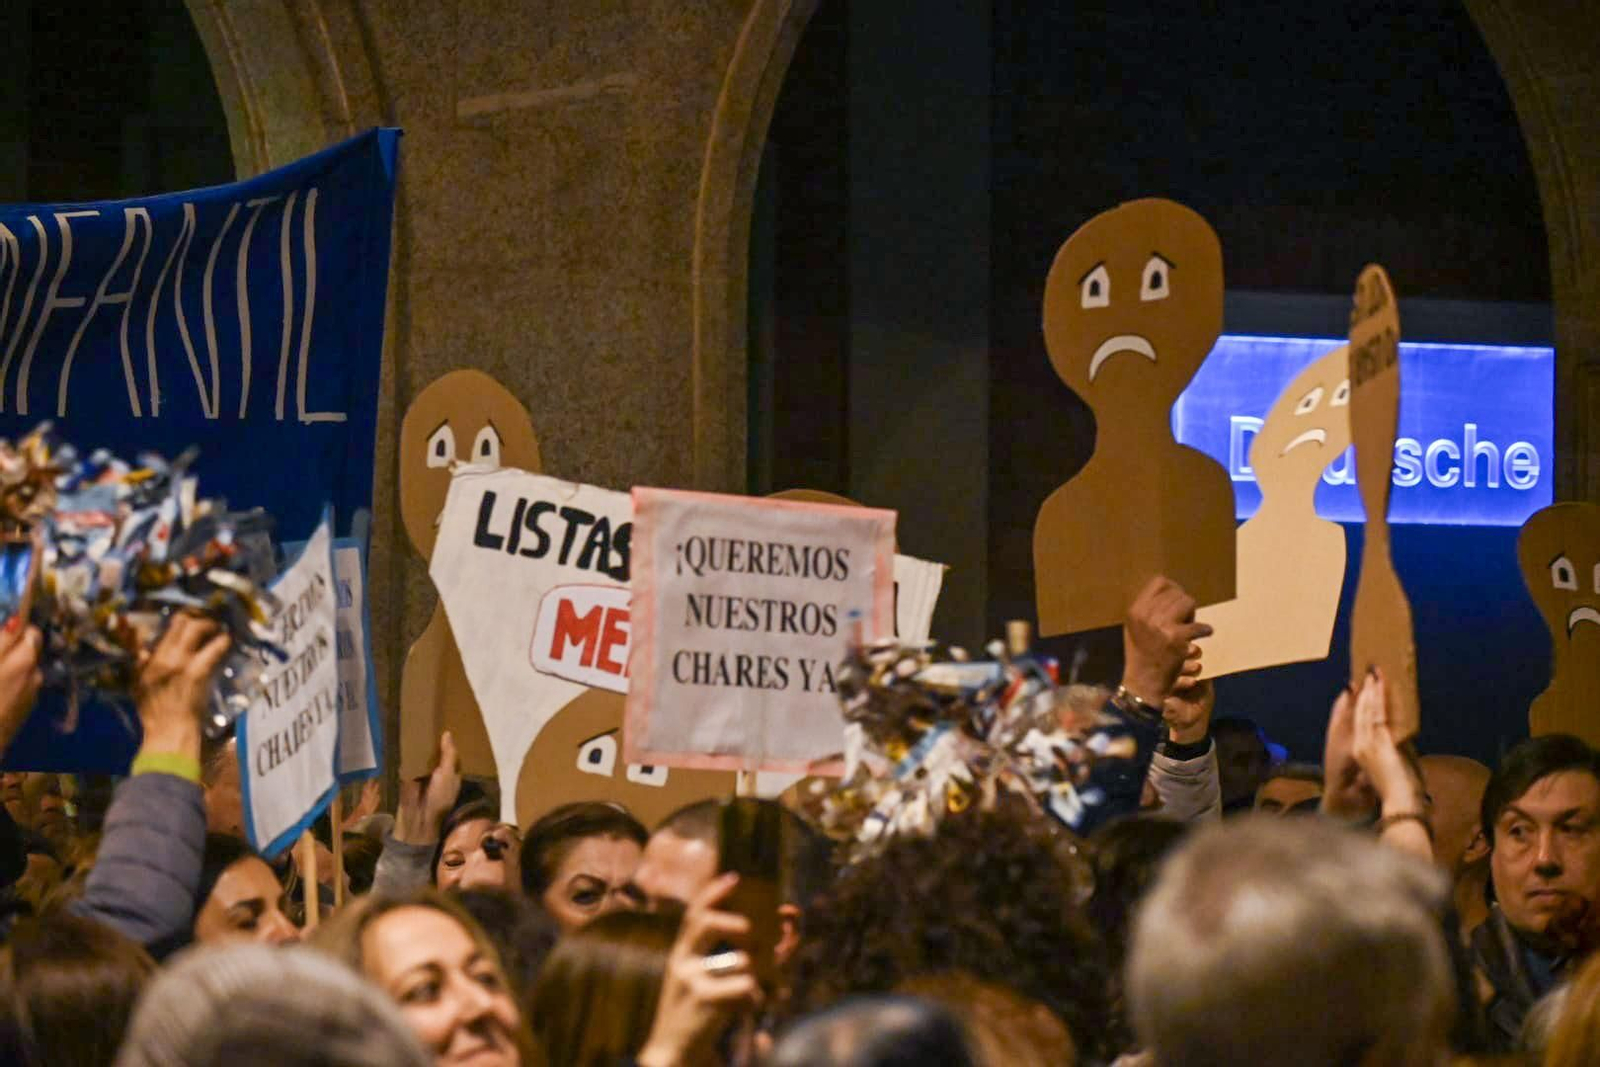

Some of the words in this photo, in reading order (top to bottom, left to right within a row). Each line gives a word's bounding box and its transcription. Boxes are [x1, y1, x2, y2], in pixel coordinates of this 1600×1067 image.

[1230, 416, 1540, 489] Dusche
[474, 490, 632, 582] LISTAS
[676, 536, 850, 581] ¡QUEREMOS
[684, 593, 838, 637] NUESTROS
[673, 649, 789, 690] CHARES
[798, 659, 837, 693] YA
